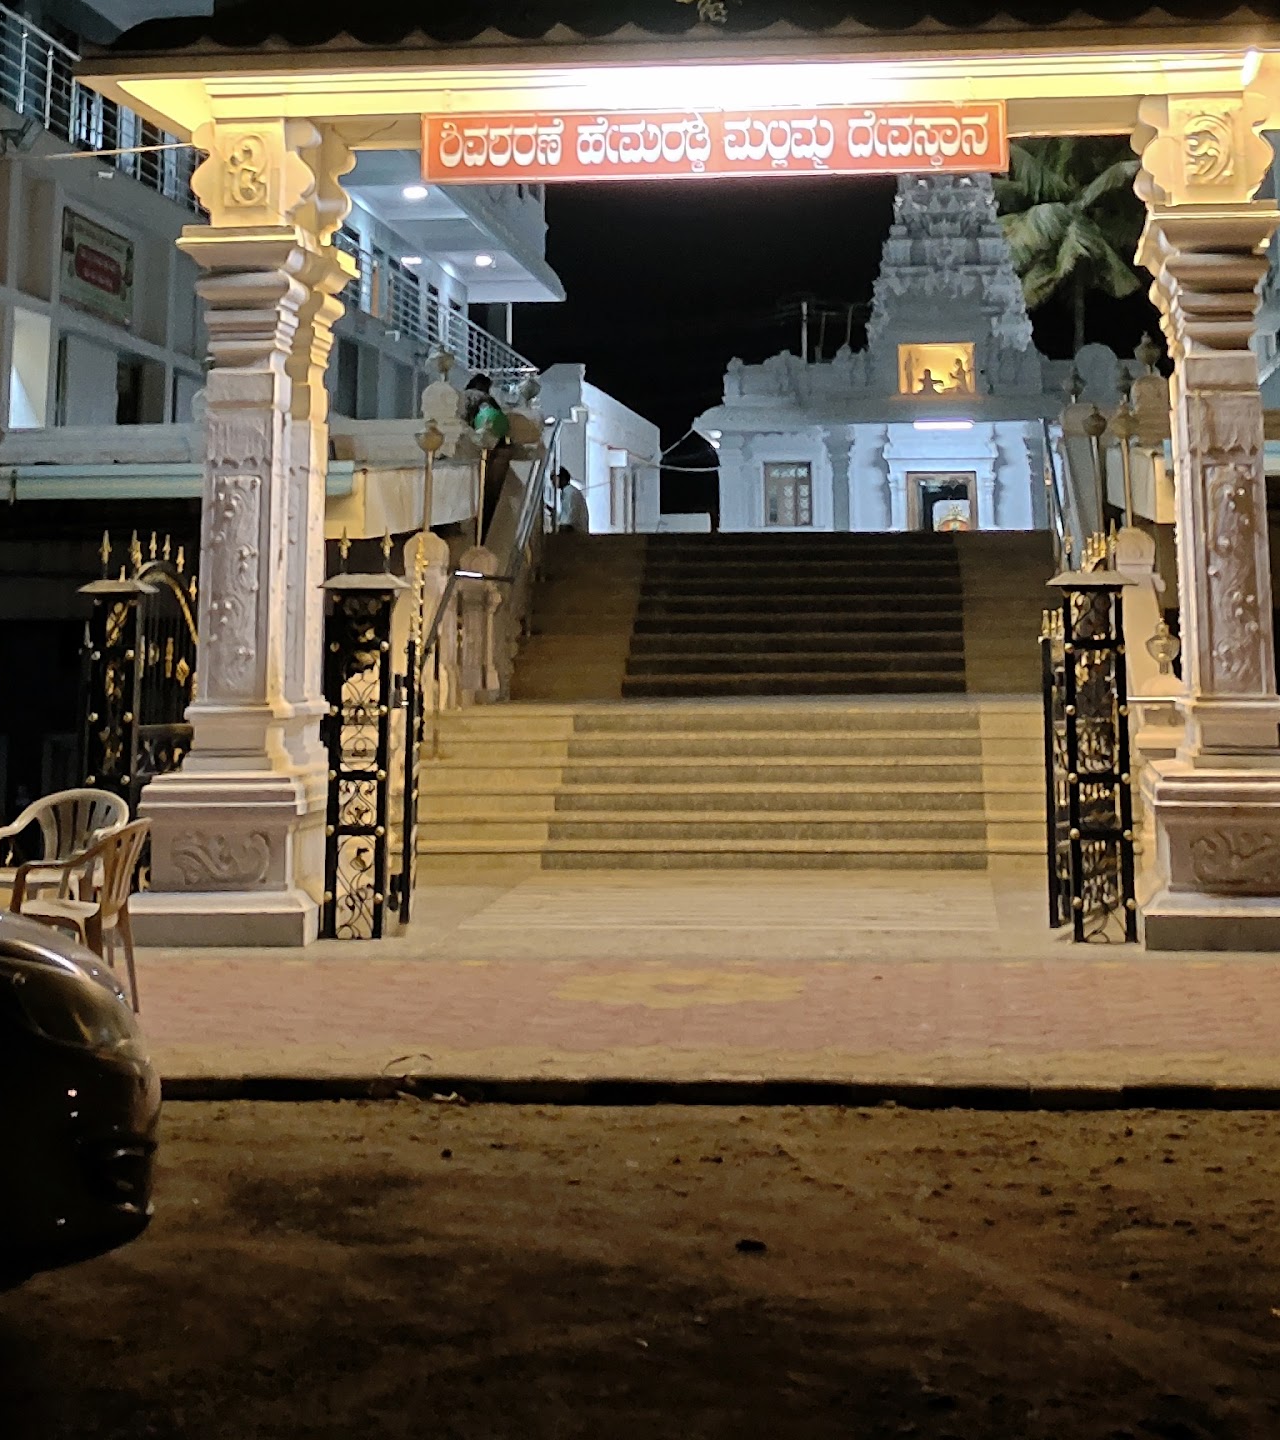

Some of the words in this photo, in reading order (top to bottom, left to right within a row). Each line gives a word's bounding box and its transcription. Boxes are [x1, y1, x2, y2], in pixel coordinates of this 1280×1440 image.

[438, 117, 564, 168] ಶಿವಶರಣೆ
[723, 113, 835, 169] ಮಲ್ಲಮ್ಮ
[847, 110, 990, 167] ದೇವಸ್ಥಾನ
